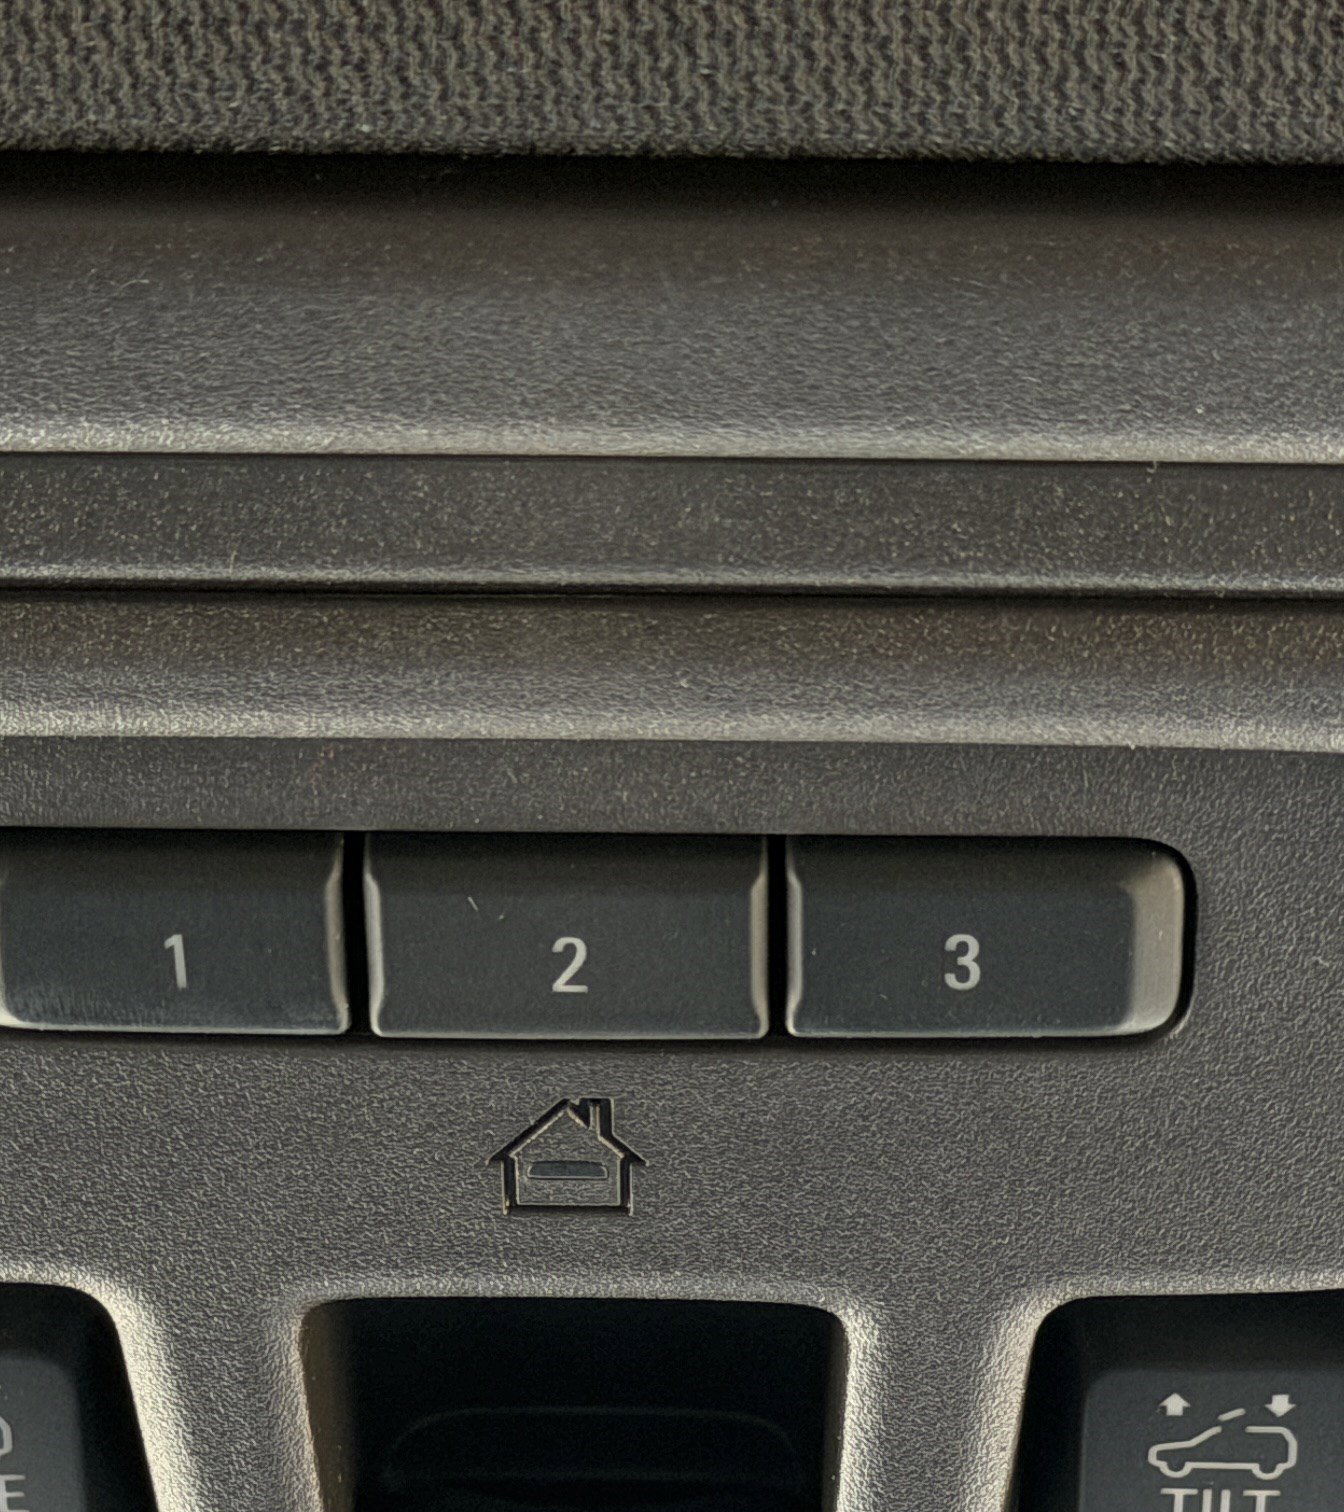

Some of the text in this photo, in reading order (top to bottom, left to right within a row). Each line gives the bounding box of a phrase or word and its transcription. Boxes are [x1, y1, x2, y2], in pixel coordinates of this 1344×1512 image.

[163, 933, 190, 990] 1
[550, 936, 590, 995] 2
[943, 934, 983, 992] 3
